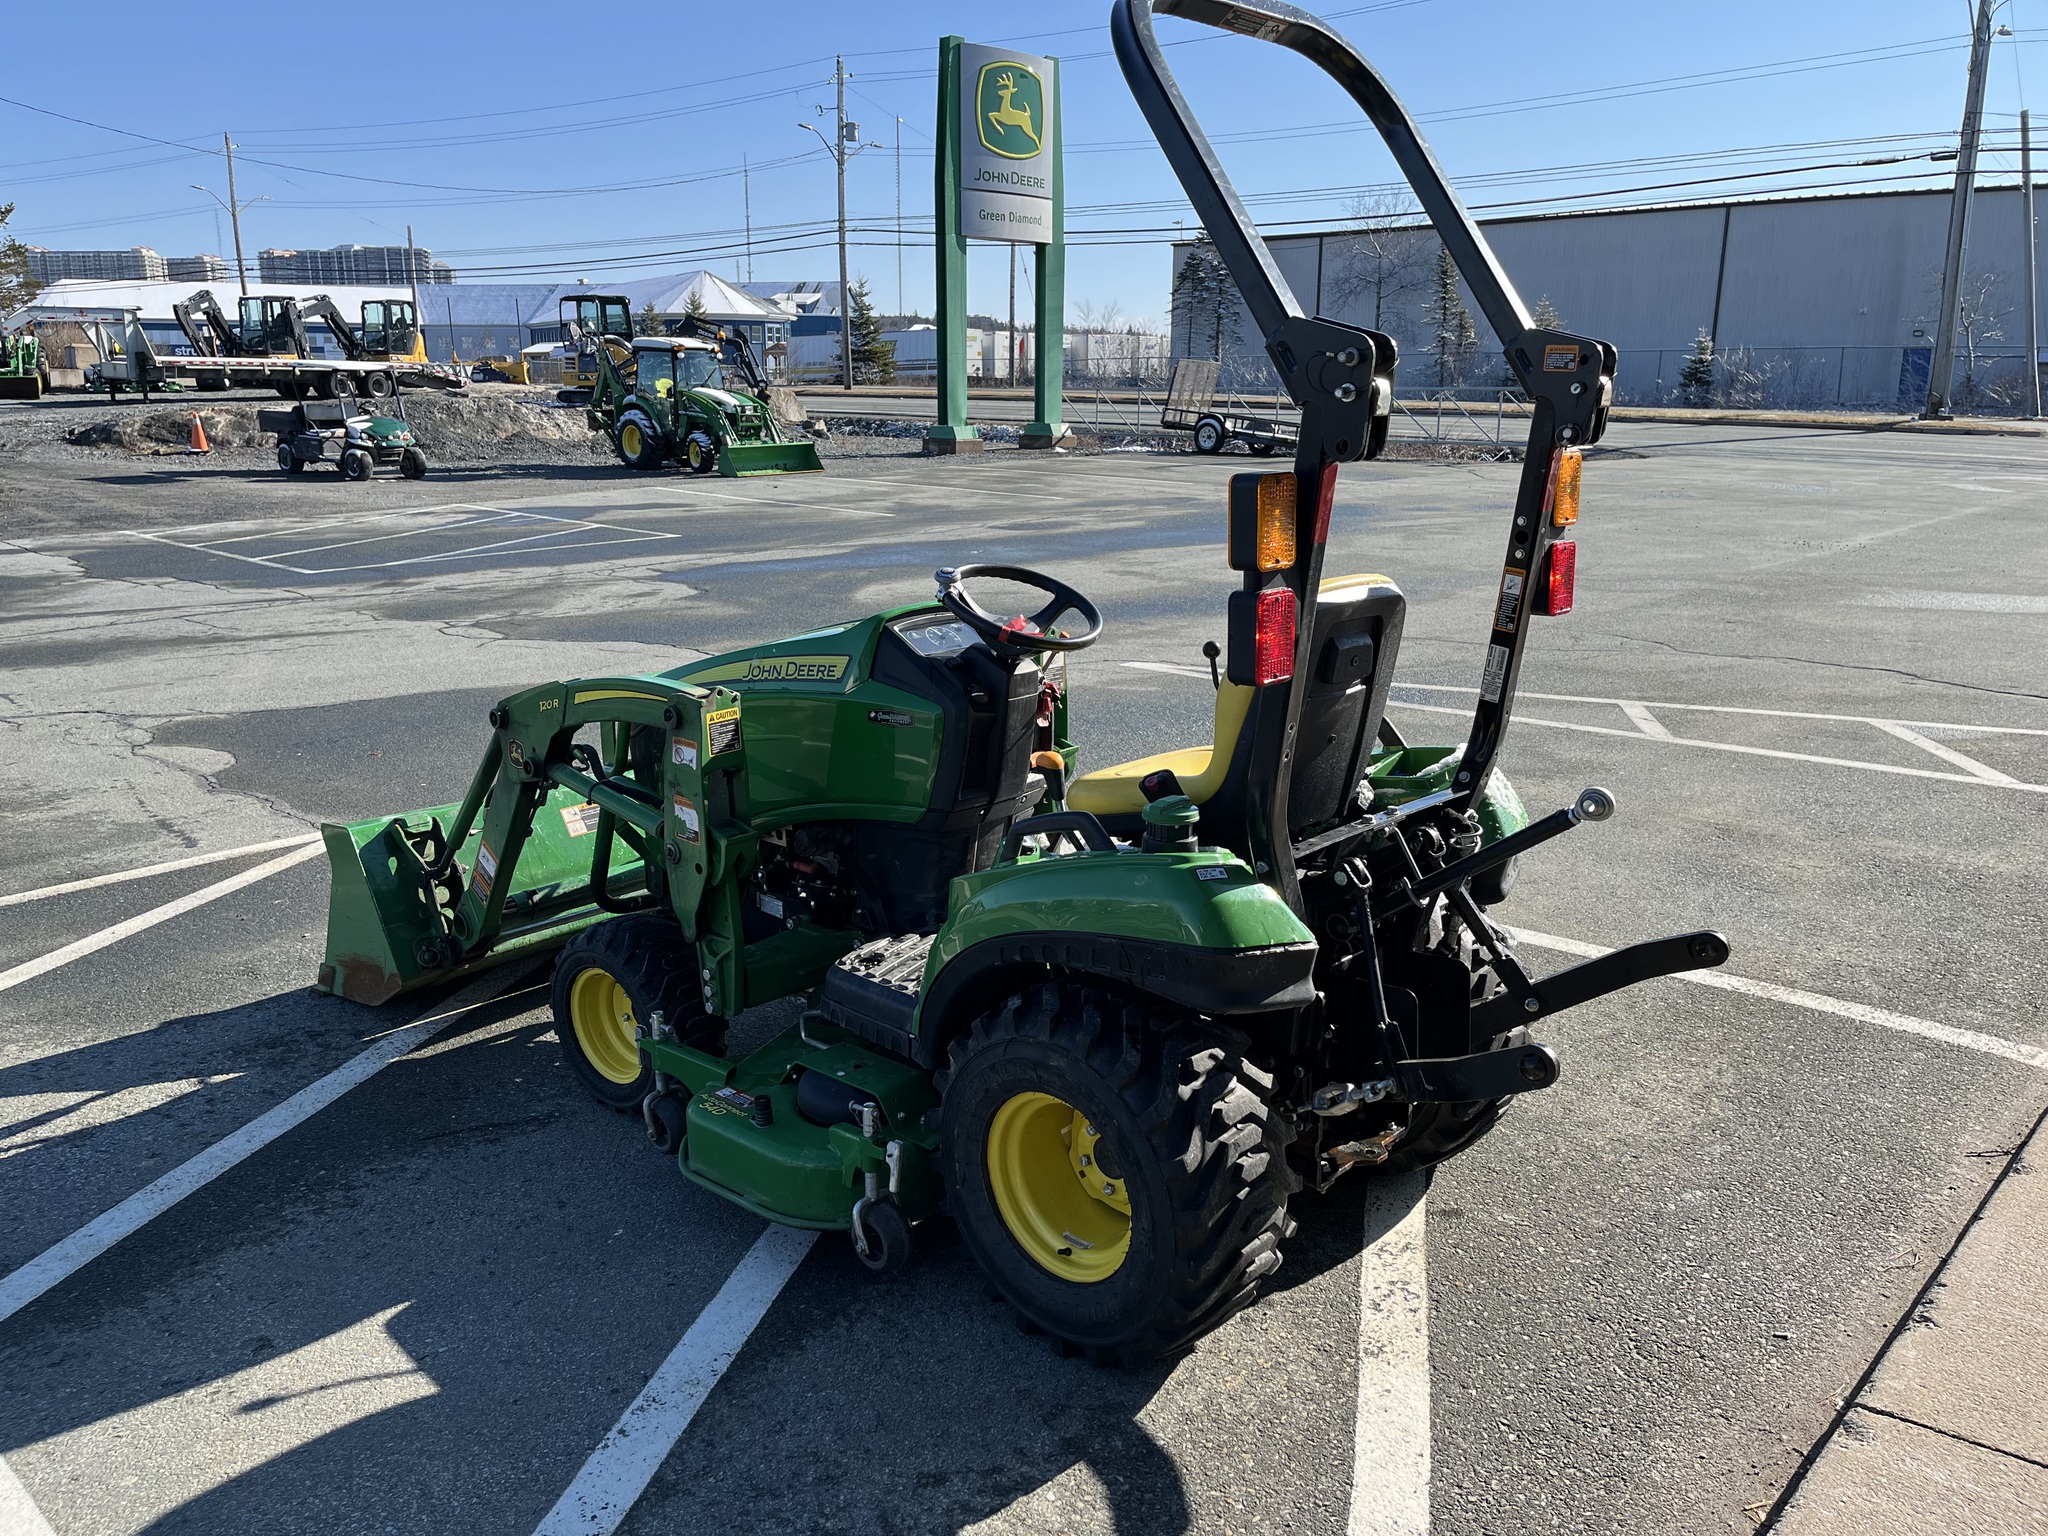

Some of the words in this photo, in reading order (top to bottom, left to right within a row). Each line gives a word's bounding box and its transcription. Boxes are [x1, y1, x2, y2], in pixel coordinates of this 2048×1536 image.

[974, 167, 1009, 184] JOHN
[1011, 171, 1045, 189] DEERE
[979, 209, 1006, 222] Green
[1008, 211, 1042, 226] Diamond
[697, 329, 715, 339] DEERE
[742, 661, 782, 679] JOHN
[785, 661, 837, 679] DEERE
[715, 709, 738, 720] CAUTION
[698, 1101, 727, 1115] 54D
